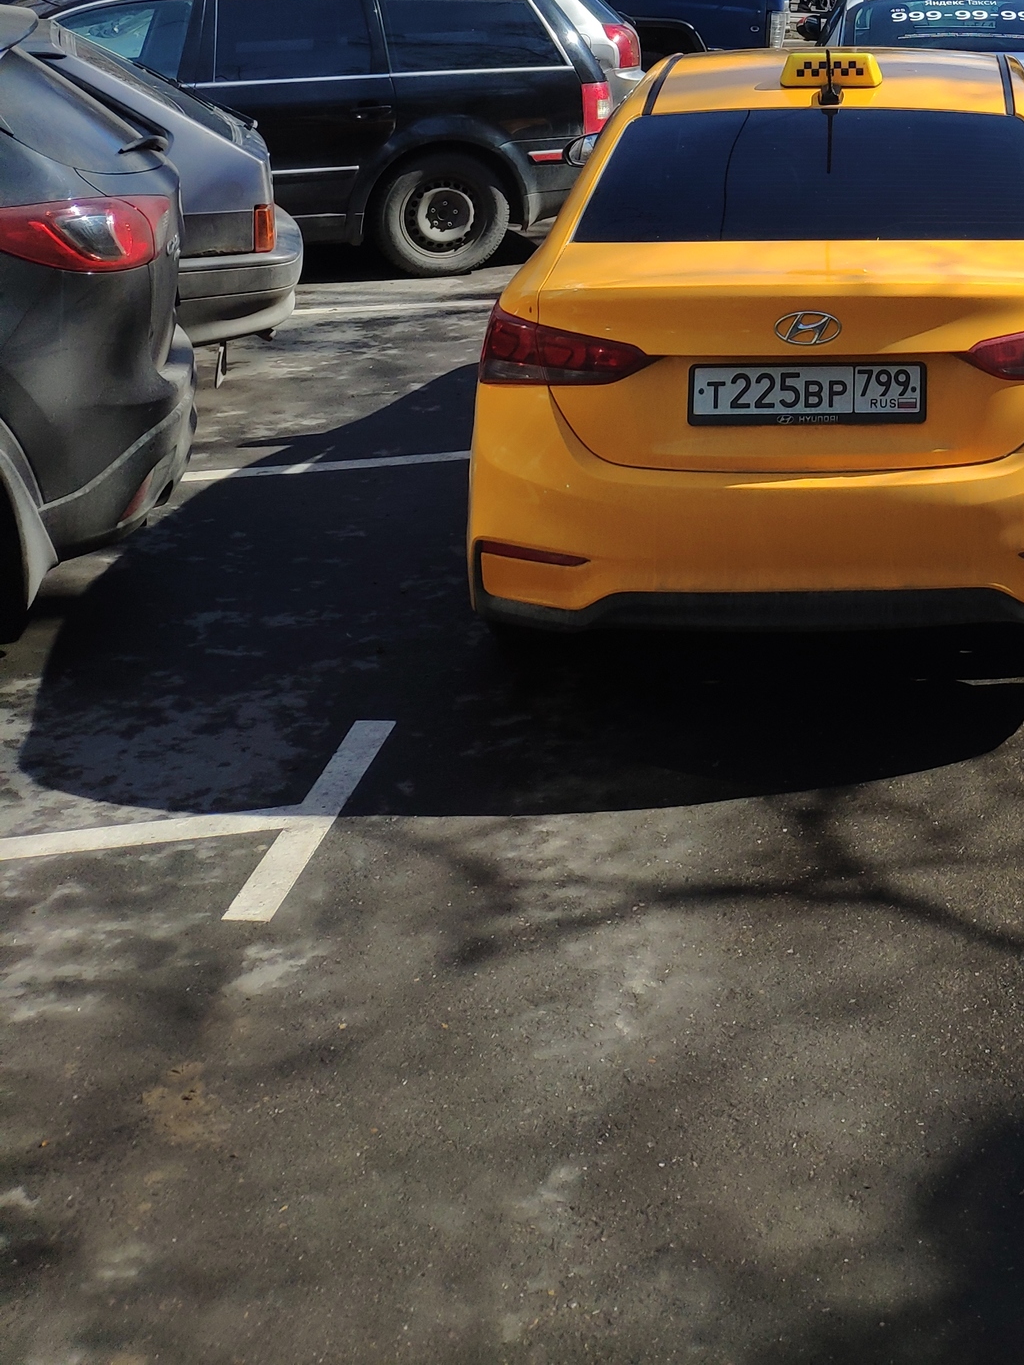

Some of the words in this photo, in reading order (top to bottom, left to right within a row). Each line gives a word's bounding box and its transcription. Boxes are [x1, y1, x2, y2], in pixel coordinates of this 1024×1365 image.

[706, 372, 848, 410] Т225ВР
[857, 369, 912, 397] 799
[869, 398, 897, 409] RUS
[798, 415, 840, 424] HYUNDAI
